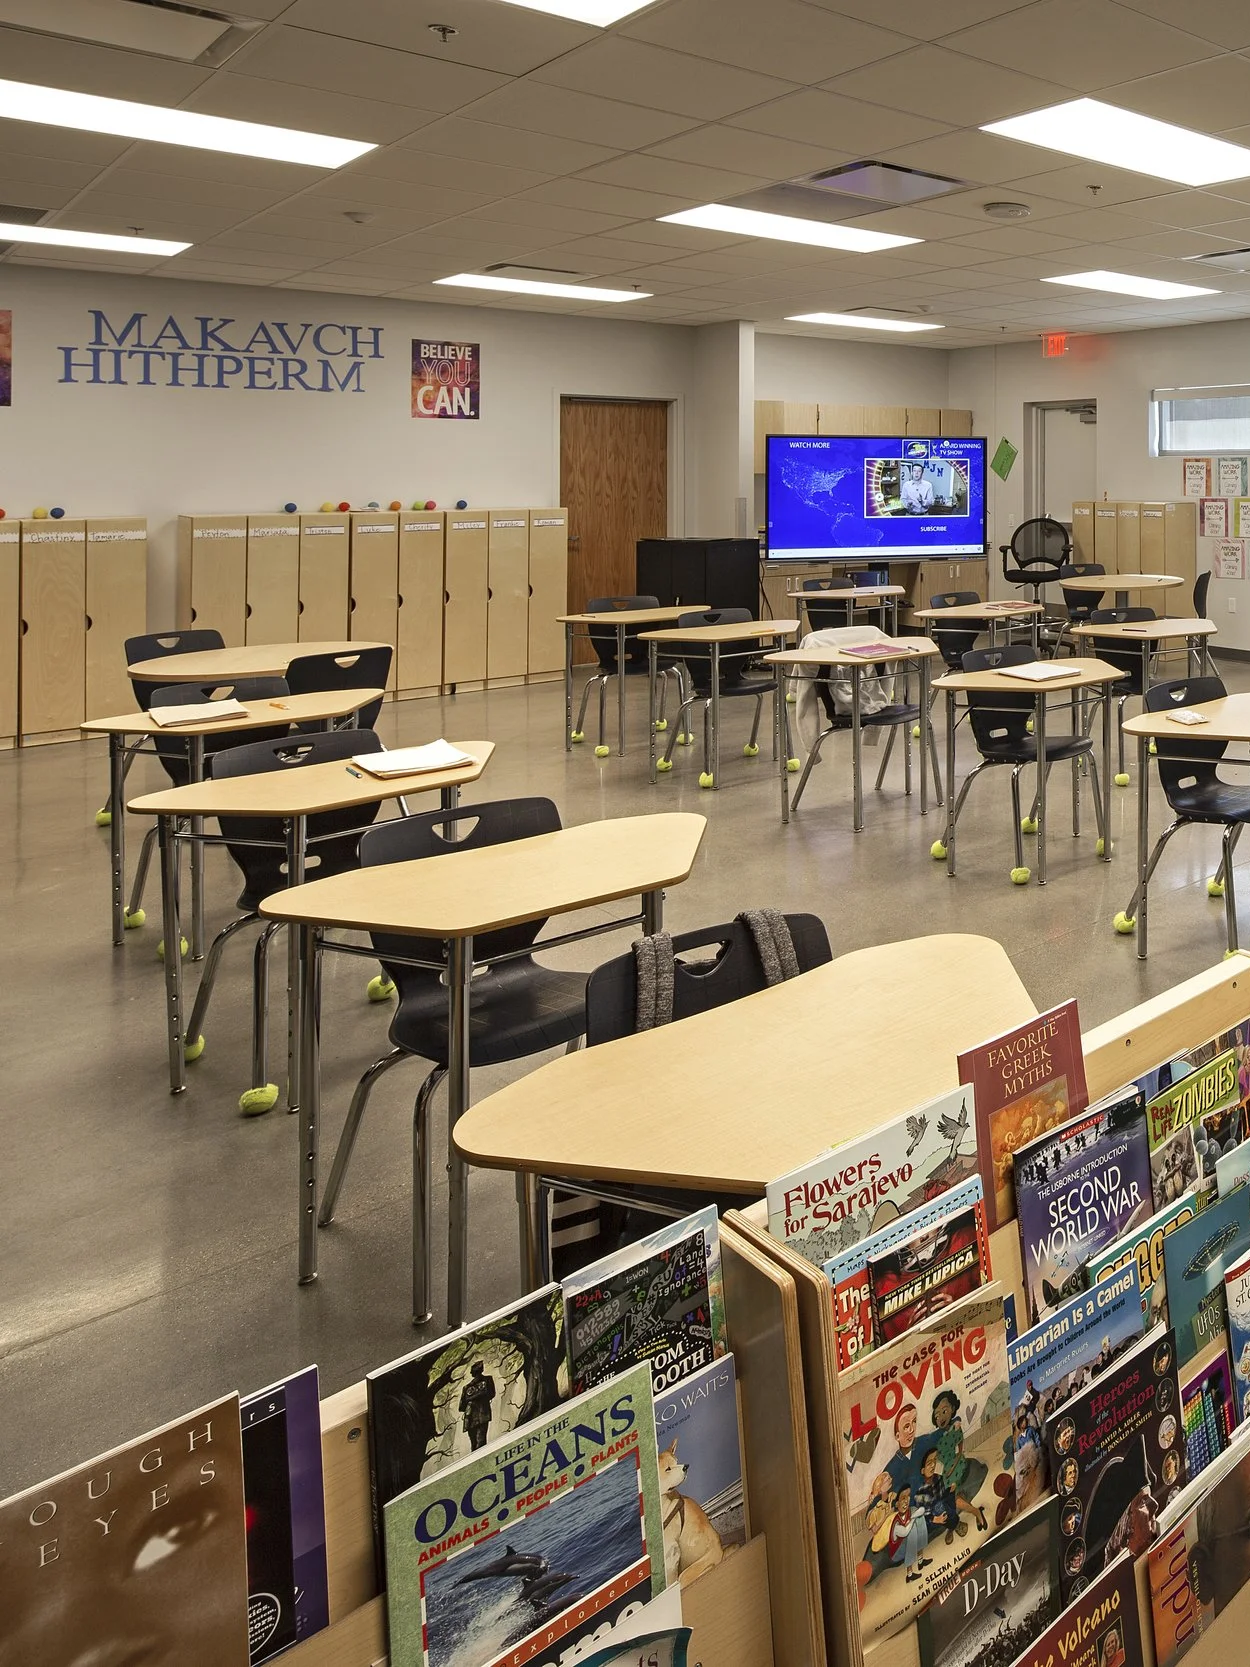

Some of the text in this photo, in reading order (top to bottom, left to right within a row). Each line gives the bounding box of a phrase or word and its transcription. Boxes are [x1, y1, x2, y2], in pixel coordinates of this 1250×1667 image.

[87, 309, 385, 359] MAKAVCH
[420, 343, 472, 361] BELIEVE
[56, 346, 366, 393] HITHPERM
[420, 359, 471, 386] YOU
[416, 385, 475, 416] CAN.
[789, 441, 831, 449] WATCH MORE
[987, 1021, 1059, 1068] FAVORITE
[1001, 1043, 1053, 1079] GREEK
[1004, 1059, 1053, 1099] MYTHS
[1172, 1057, 1236, 1133] ZOMBIES
[1066, 1114, 1104, 1136] SCHOLASTIC
[1151, 1100, 1175, 1121] REAL
[1152, 1118, 1174, 1143] LIFE
[783, 1153, 882, 1218] Flowers
[1037, 1143, 1129, 1201] THE USBORNE INTRODUCTION
[784, 1162, 913, 1238] for Sarajevo
[1048, 1165, 1122, 1228] SECOND
[1030, 1206, 1100, 1268] WORLD
[1100, 1181, 1142, 1222] WAR
[679, 1245, 704, 1266] Land
[846, 1260, 865, 1273] Maps
[658, 1266, 707, 1297] Ignorance
[838, 1284, 870, 1313] The
[884, 1251, 974, 1315] MIKE LUPICA
[884, 1290, 898, 1300] NEW
[898, 1282, 911, 1293] YORK
[910, 1275, 925, 1287] TIMES
[1235, 1294, 1247, 1308] ST.
[941, 1324, 965, 1347] FOR
[1007, 1269, 1135, 1372] Librarian Is a Camel
[1196, 1305, 1221, 1336] UFOs
[1010, 1299, 1126, 1386] Books Are Brought to Children Around the World
[680, 1369, 729, 1410] WAITS
[1089, 1369, 1141, 1418] Heroes
[1077, 1384, 1156, 1456] Revolution
[1100, 1411, 1141, 1449] DAVID ADLER
[1107, 1409, 1154, 1453] DONALD SMITH
[494, 1416, 570, 1466] LIFE IN THE
[413, 1393, 636, 1544] OCEANS
[416, 1429, 639, 1566] ANIMALS PEOPLE PLANTS
[924, 1547, 971, 1584] SELINA ALKO
[962, 1550, 1027, 1617] D-Day
[911, 1587, 931, 1606] SEAN
[932, 1567, 960, 1592] QUALLS
[939, 1573, 961, 1601] TRUE
[1057, 1589, 1120, 1660] Volcano
